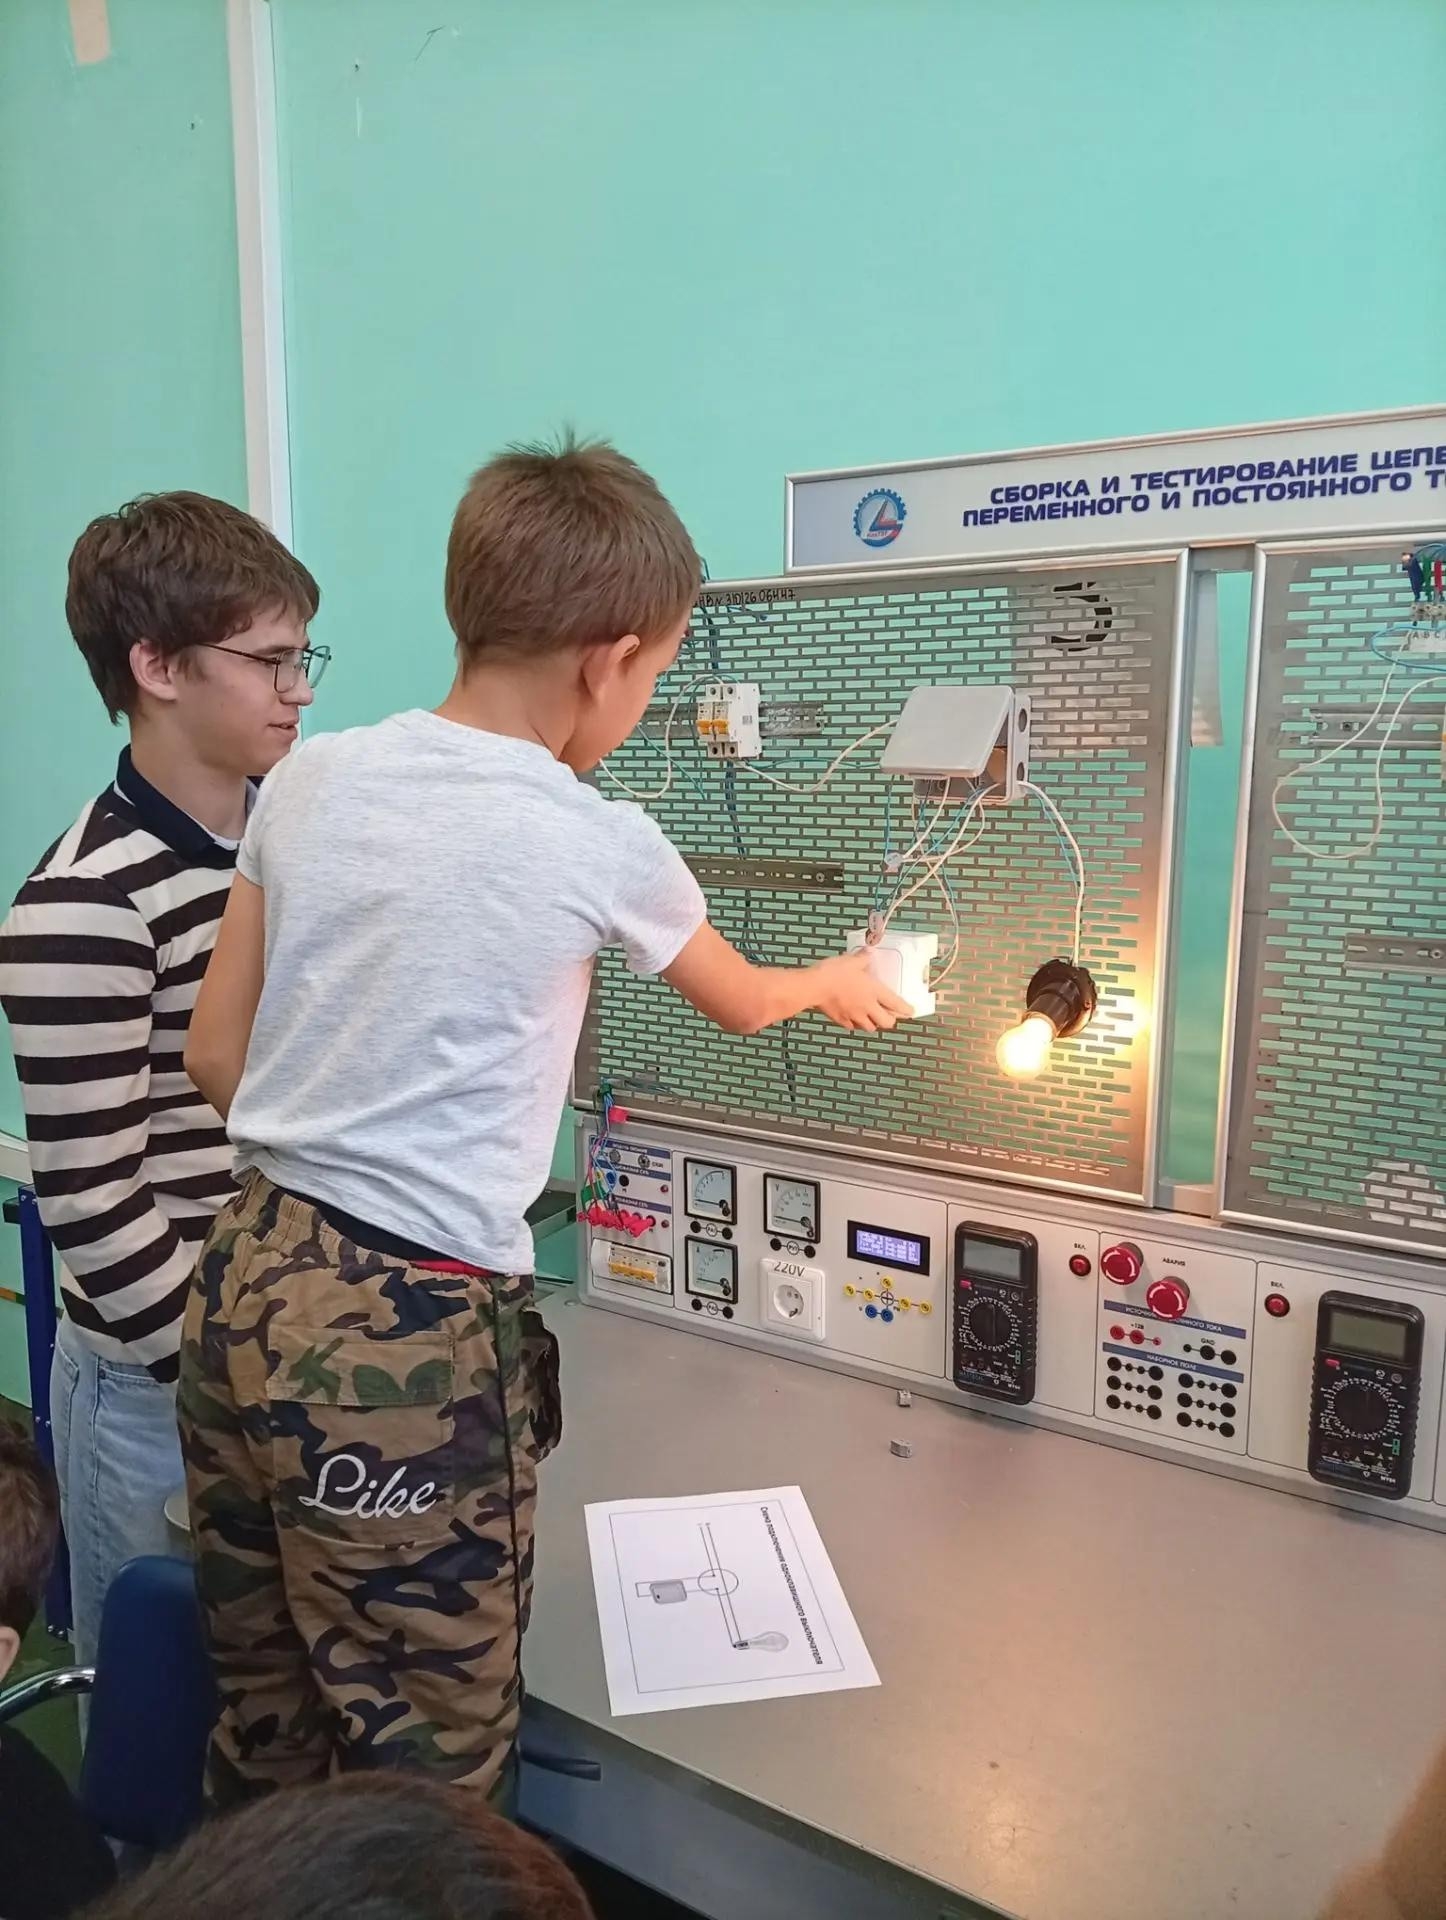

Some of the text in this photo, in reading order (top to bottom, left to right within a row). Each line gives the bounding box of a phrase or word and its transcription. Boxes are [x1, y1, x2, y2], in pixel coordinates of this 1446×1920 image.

[963, 469, 1446, 527] ПЕРЕМЕННОГО И ПОСТОЯННОГО Т
[990, 479, 1090, 505] СБОРКА
[1101, 476, 1120, 495] И
[1131, 454, 1358, 491] ТЕСТИРОВАНИЕ
[773, 1261, 805, 1277] 220V
[298, 1454, 437, 1519] Like
[800, 1618, 823, 1664] выключателя
